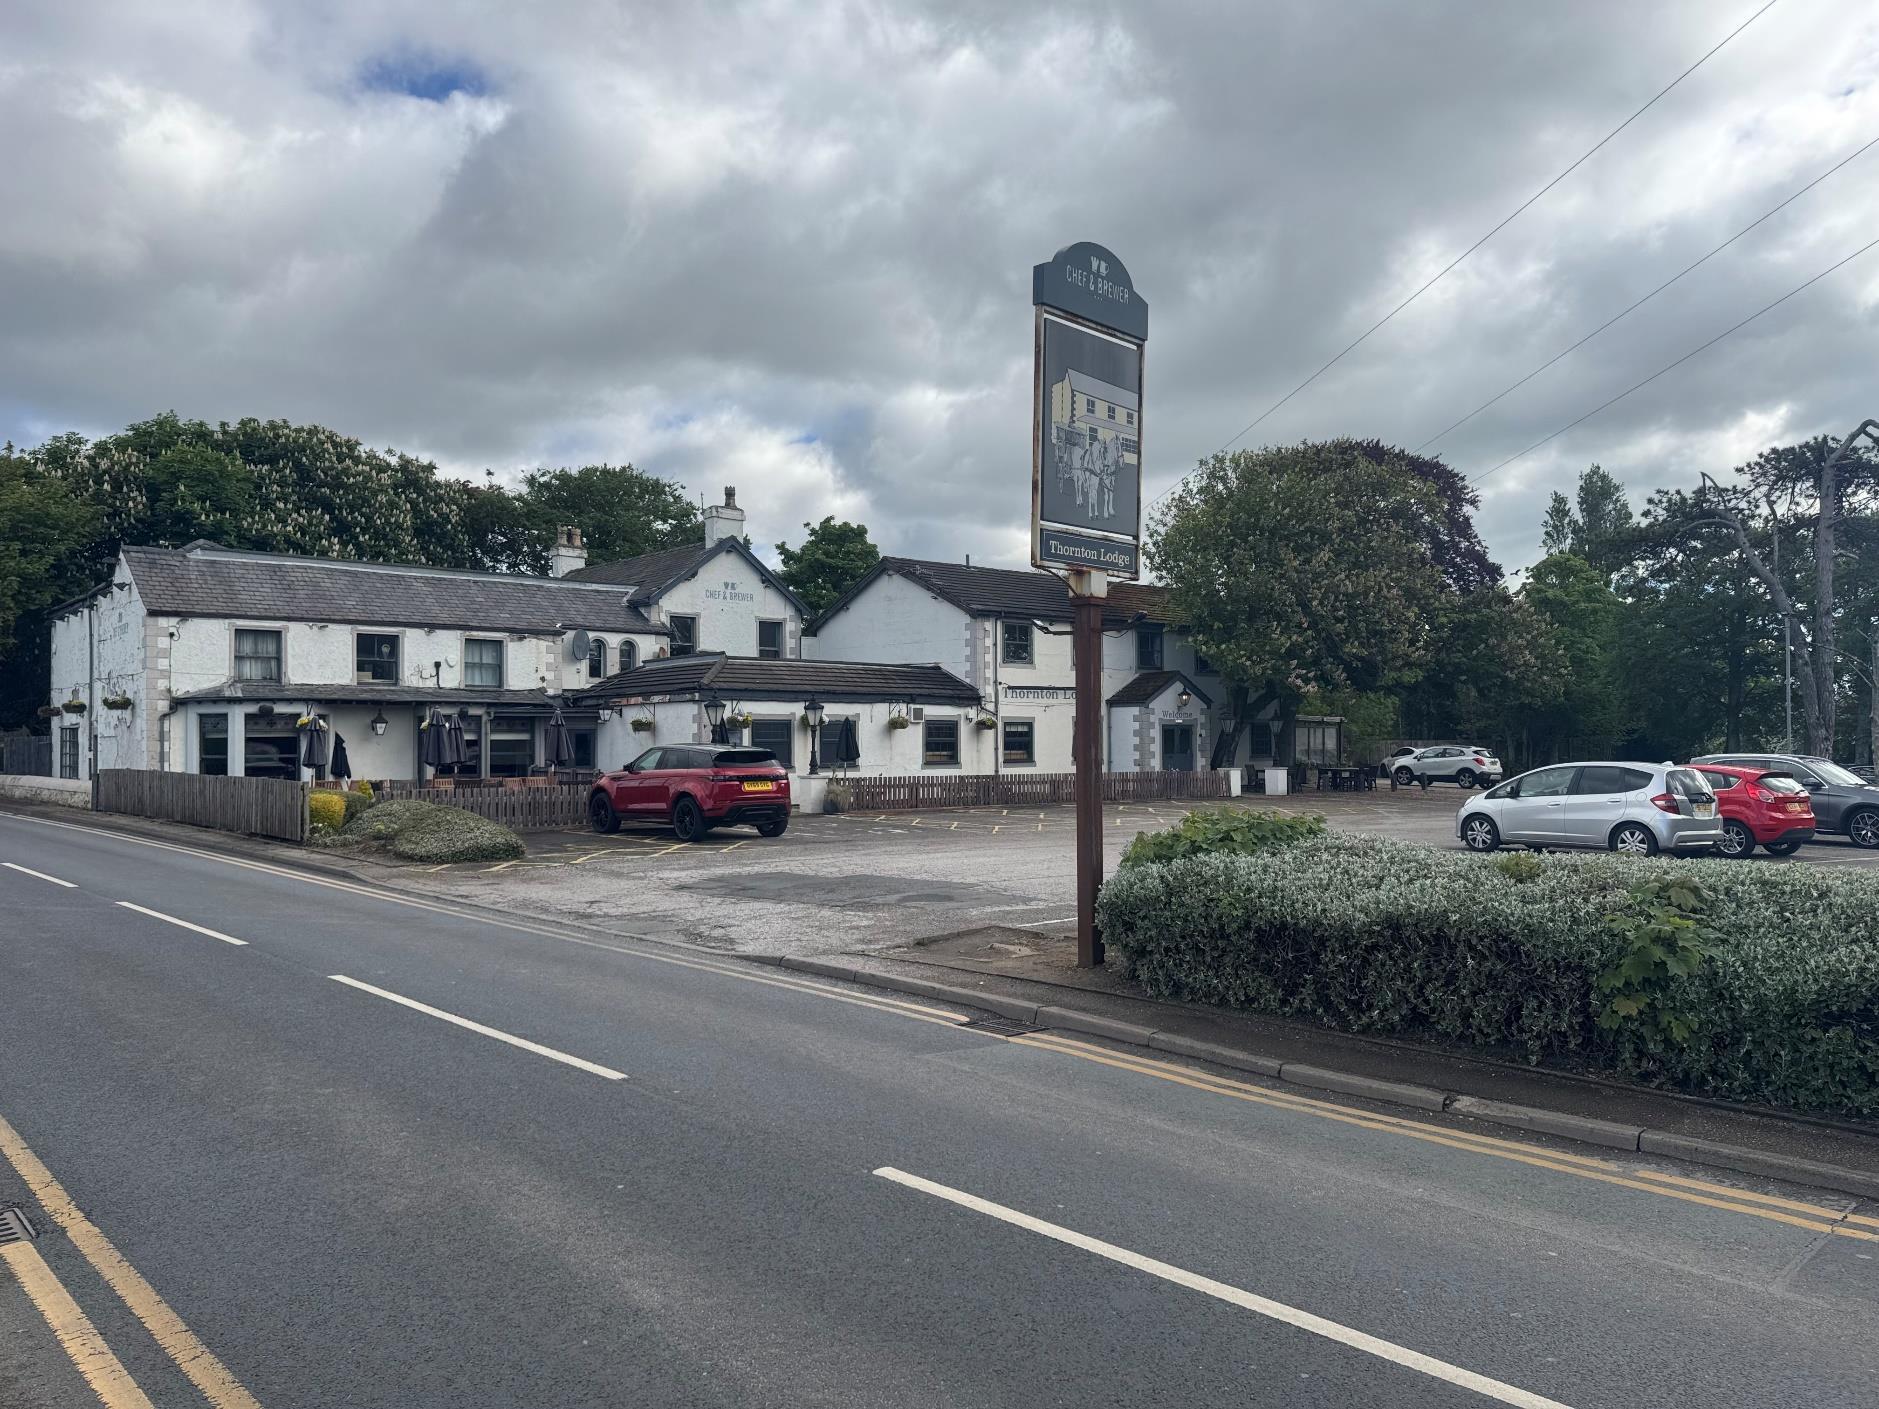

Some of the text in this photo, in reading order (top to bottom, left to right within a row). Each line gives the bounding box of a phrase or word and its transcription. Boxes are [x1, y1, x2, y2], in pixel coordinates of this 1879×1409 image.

[1066, 264, 1129, 304] CHEF & BREWER
[1049, 540, 1130, 566] Thornton Lodge
[705, 589, 754, 602] CHEF & BREWER
[1002, 686, 1058, 699] Thornton
[1161, 710, 1193, 719] Welcome
